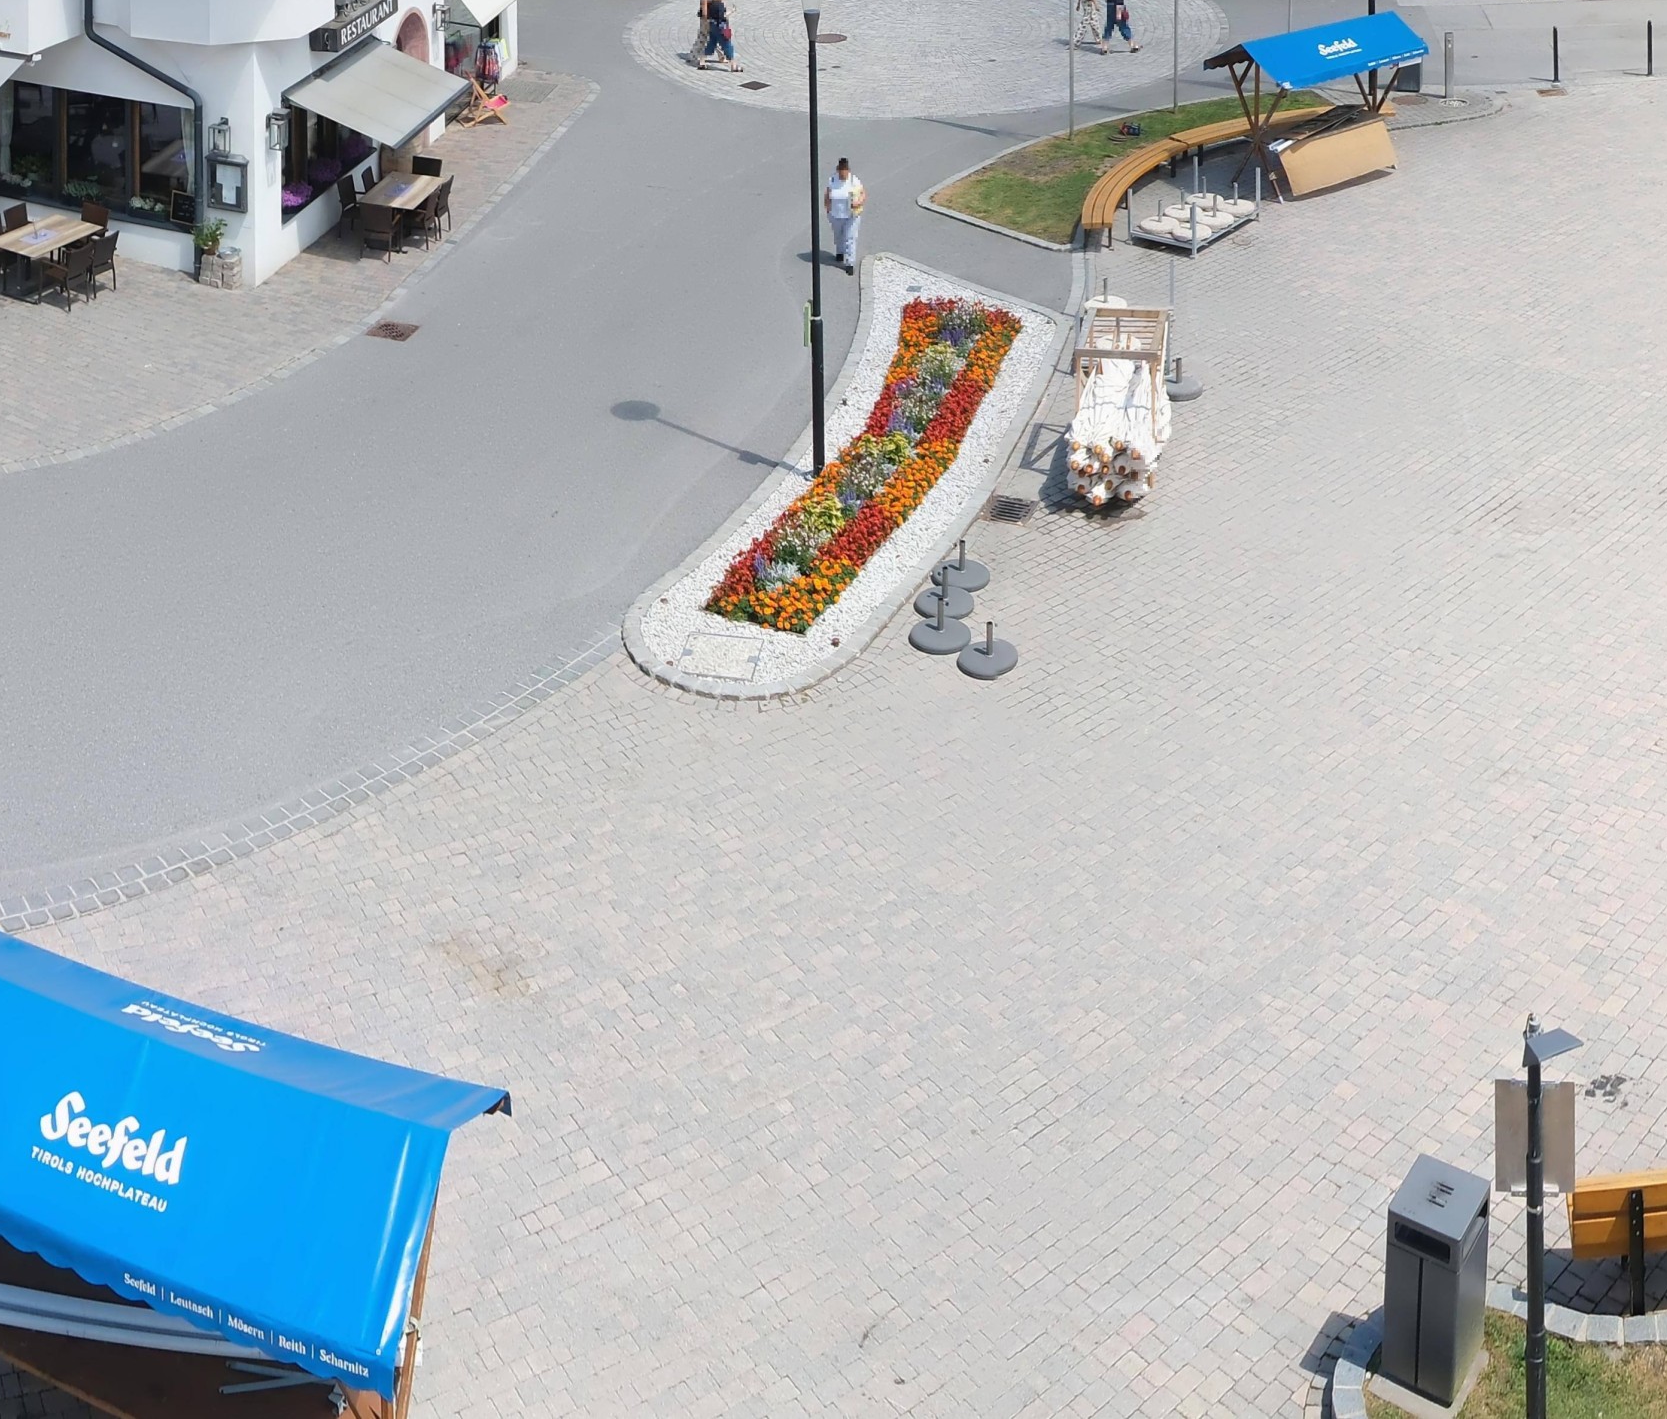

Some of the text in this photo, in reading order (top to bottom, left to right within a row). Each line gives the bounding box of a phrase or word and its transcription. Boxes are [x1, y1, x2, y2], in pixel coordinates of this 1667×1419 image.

[1317, 38, 1358, 56] Seefeld
[121, 1002, 265, 1054] Seefeld
[39, 1090, 188, 1186] Seefeld
[30, 1145, 168, 1213] TIROLS HOCHPLATEAU
[124, 1272, 370, 1378] Seefeld Leutasch Mösern Reith Scharnitz
